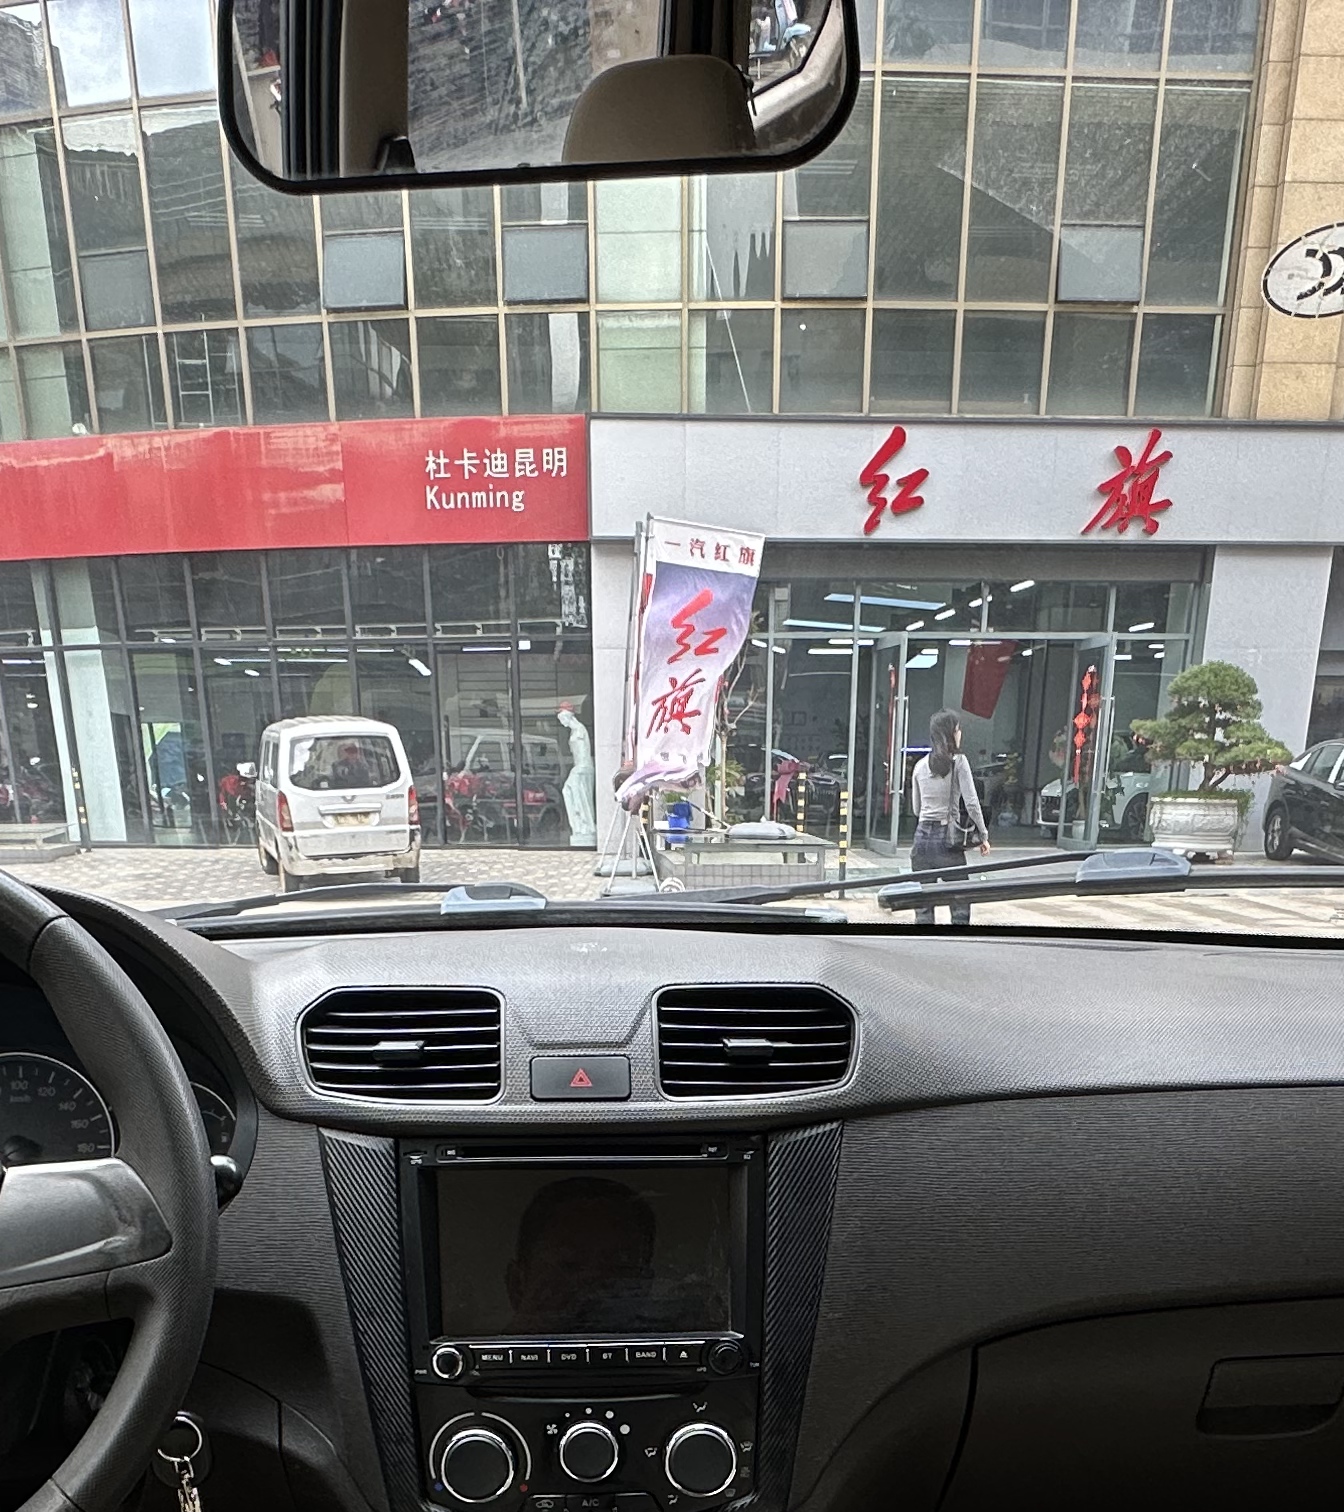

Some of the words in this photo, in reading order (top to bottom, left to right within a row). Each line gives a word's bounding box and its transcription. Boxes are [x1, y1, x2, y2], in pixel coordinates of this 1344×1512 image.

[425, 447, 567, 480] 杜卡迪昆明
[425, 484, 525, 512] Kunming
[664, 537, 756, 567] 一汽红旗
[645, 587, 728, 739] 红旗
[481, 1353, 504, 1362] MENU
[520, 1353, 539, 1362] NAVI
[635, 1351, 658, 1359] BAND
[581, 1499, 600, 1507] A/C
